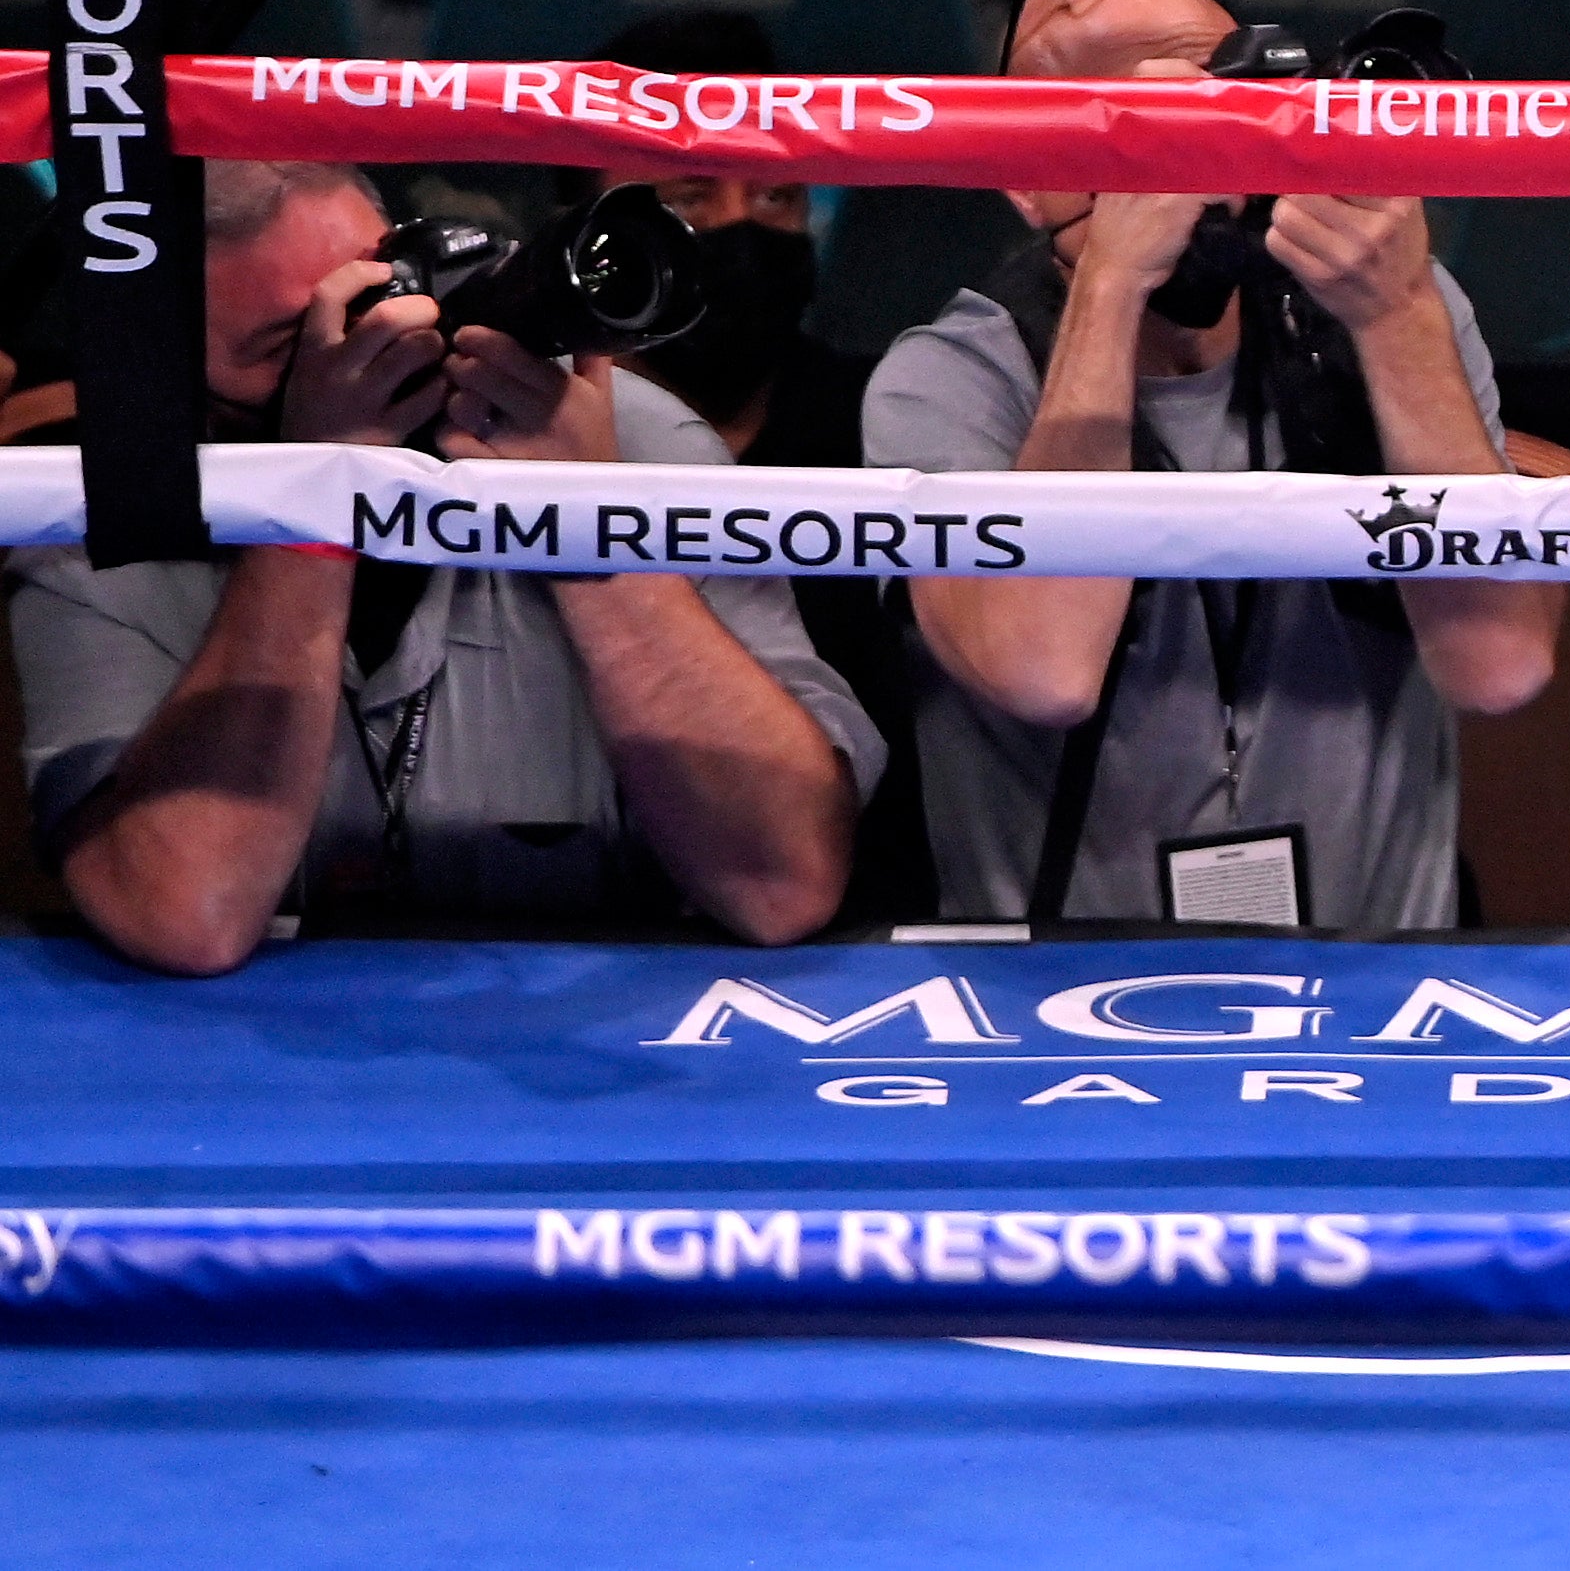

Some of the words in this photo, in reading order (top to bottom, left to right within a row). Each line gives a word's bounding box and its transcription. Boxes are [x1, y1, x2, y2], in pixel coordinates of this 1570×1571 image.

[252, 56, 468, 111] MGM
[503, 71, 935, 132] RESORTS
[352, 491, 559, 556] MGM
[597, 504, 1026, 569] RESORTS
[533, 1207, 801, 1280] MGM
[836, 1208, 1373, 1287] RESORTS
